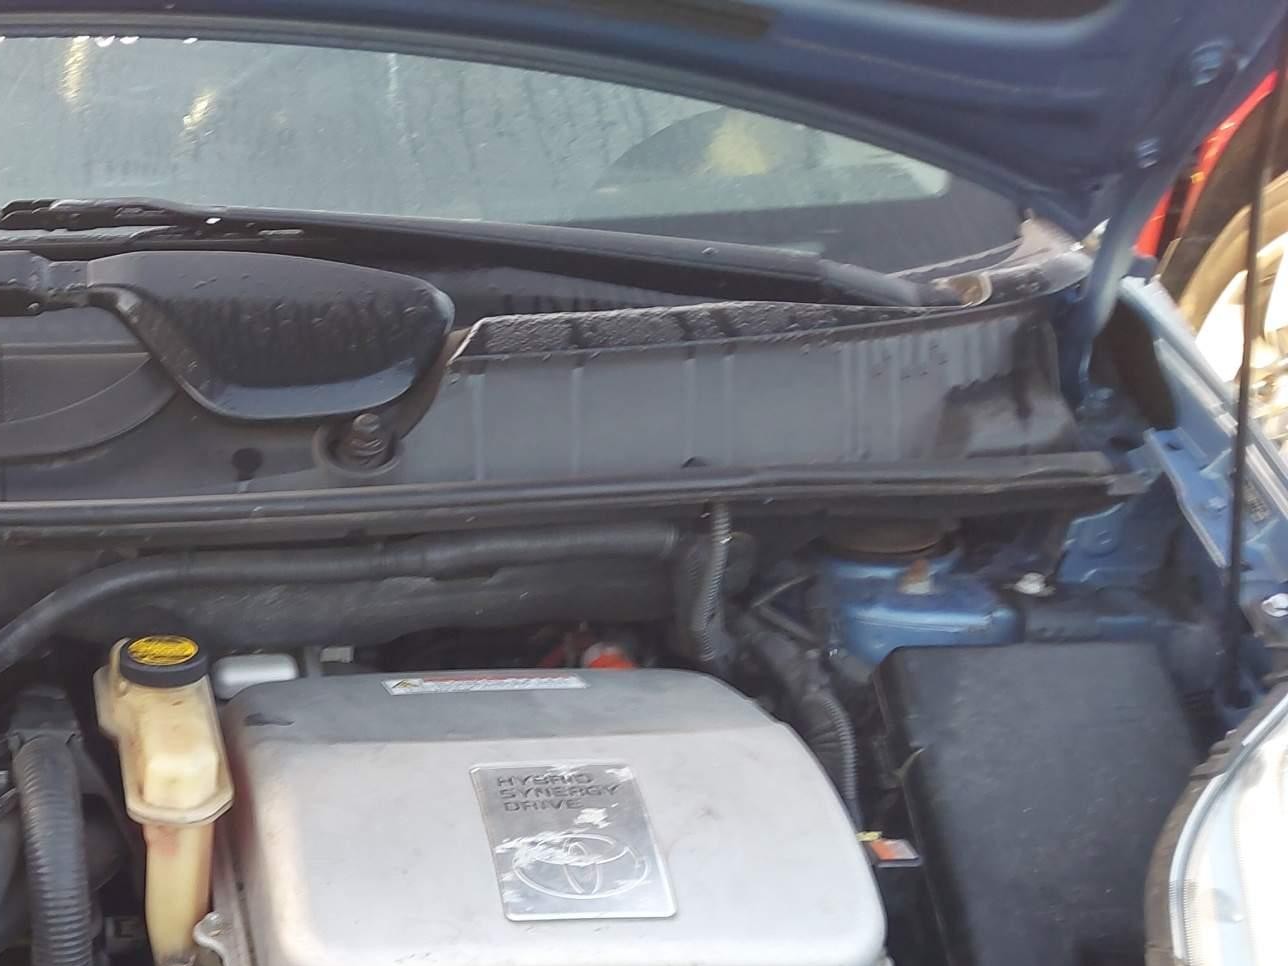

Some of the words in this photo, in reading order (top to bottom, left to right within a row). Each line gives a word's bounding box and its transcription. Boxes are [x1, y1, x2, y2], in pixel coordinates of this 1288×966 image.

[497, 773, 593, 787] HYBRID
[499, 785, 619, 799] SYNERGY
[503, 799, 584, 812] DRIVE
